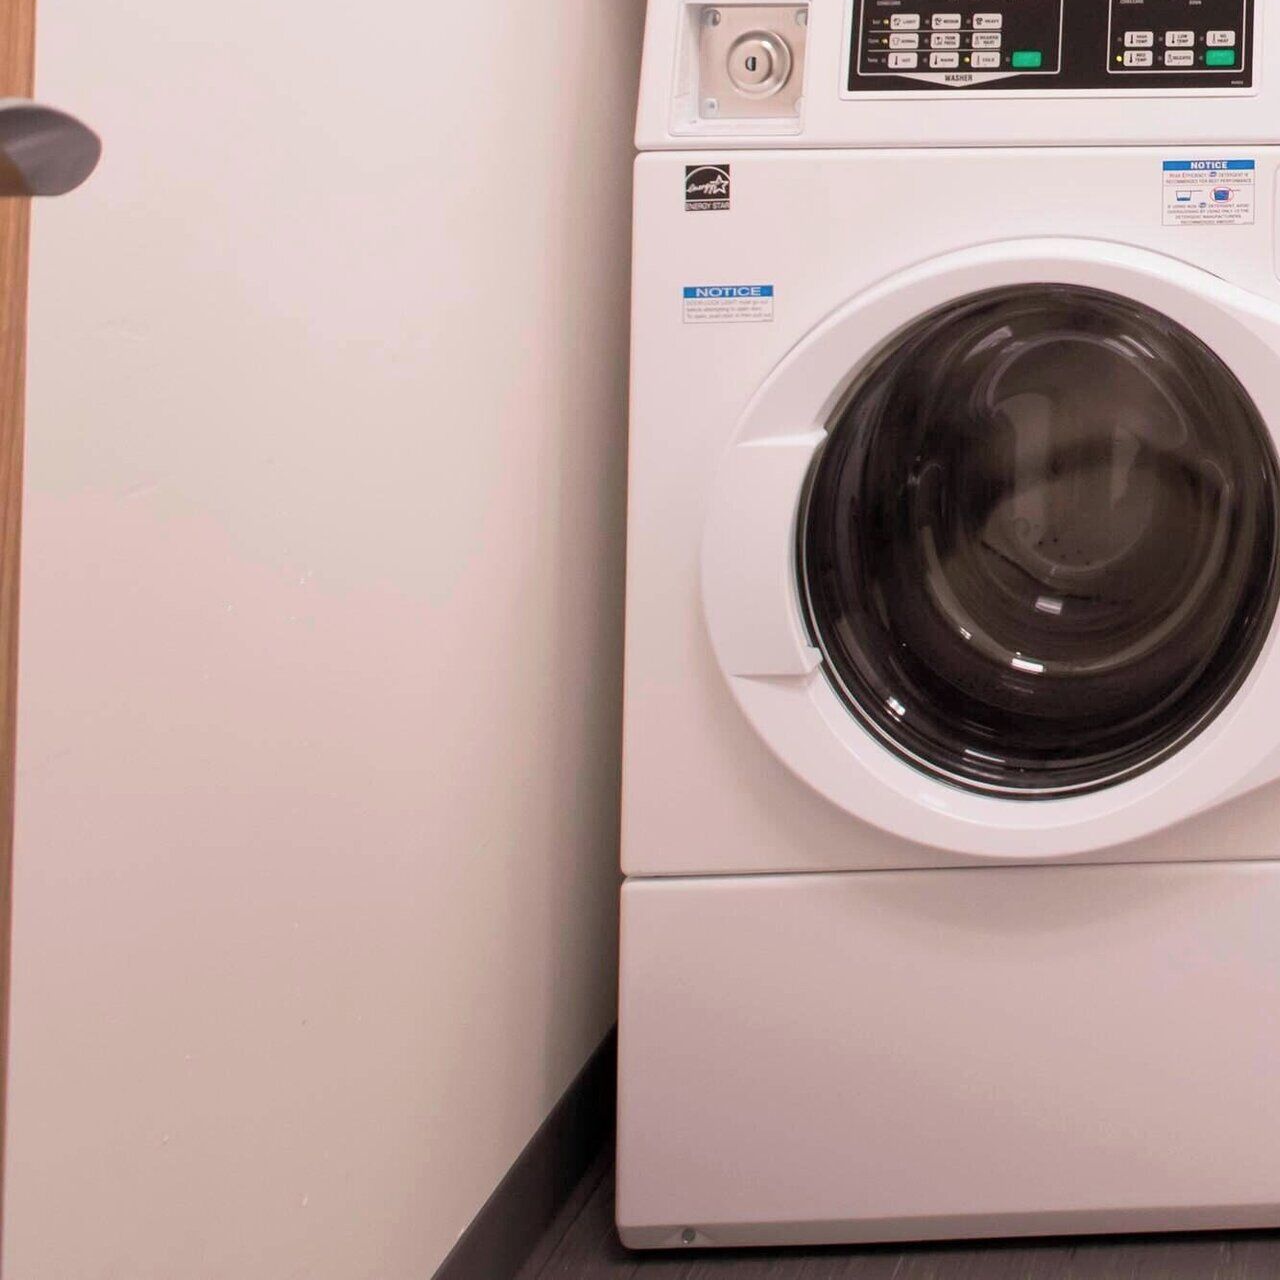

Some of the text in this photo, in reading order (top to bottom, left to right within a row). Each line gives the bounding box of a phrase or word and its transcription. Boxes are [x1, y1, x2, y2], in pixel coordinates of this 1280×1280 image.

[944, 74, 973, 82] WASHER
[1190, 162, 1228, 170] NOTICE
[685, 201, 730, 210] ENERGY STAR
[695, 287, 761, 297] NOTICE
